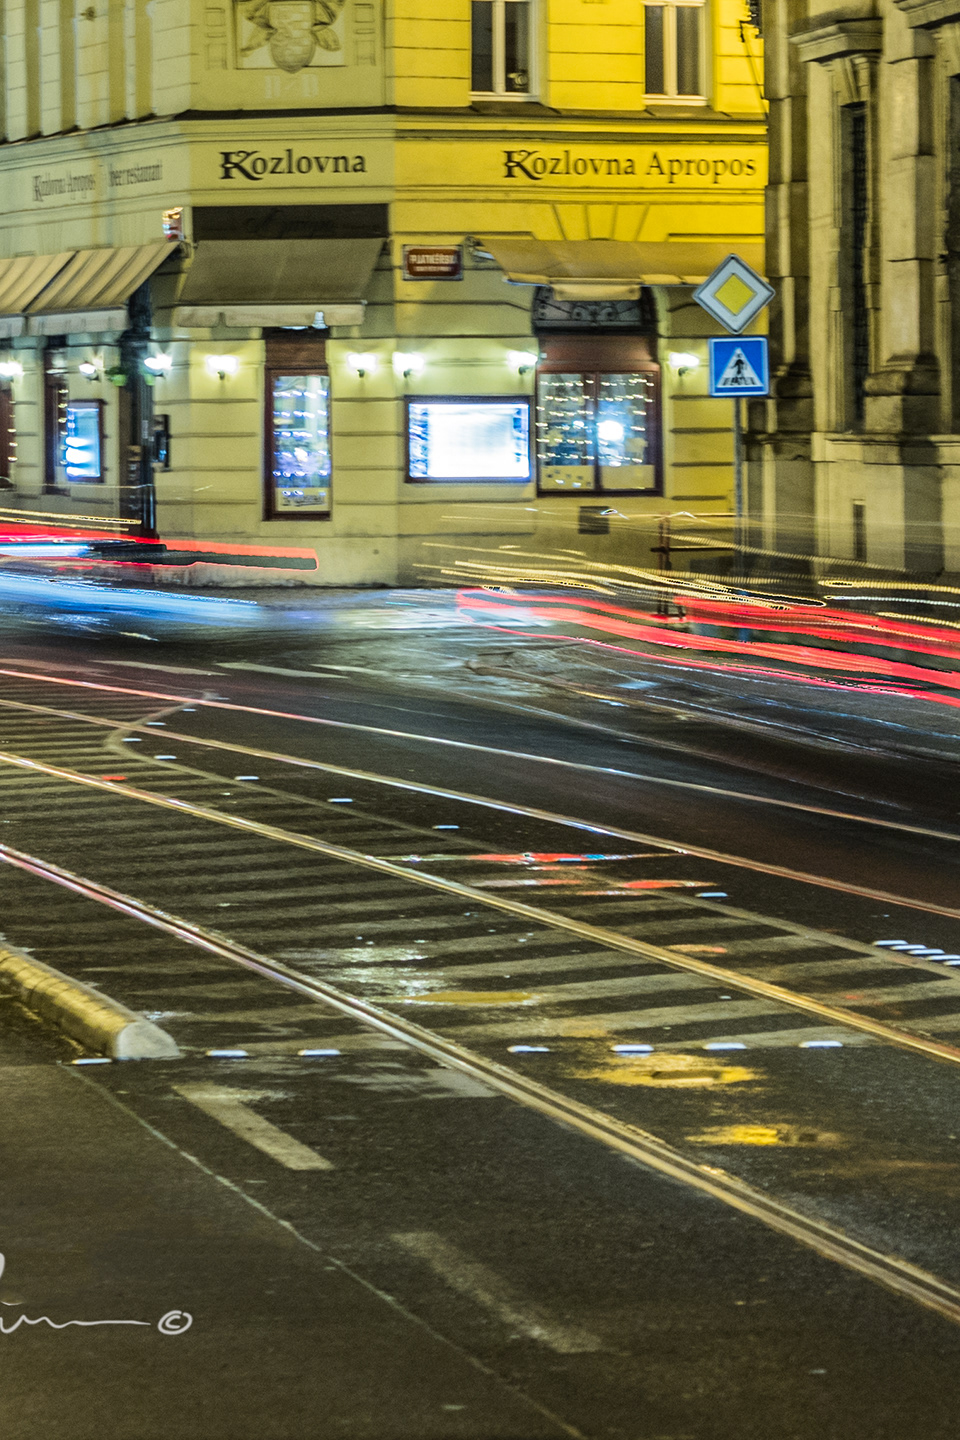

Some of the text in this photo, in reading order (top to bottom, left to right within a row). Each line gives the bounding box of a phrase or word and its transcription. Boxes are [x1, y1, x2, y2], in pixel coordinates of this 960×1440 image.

[218, 148, 368, 181] Kozlovna
[503, 149, 757, 184] Kozlovna Apropos
